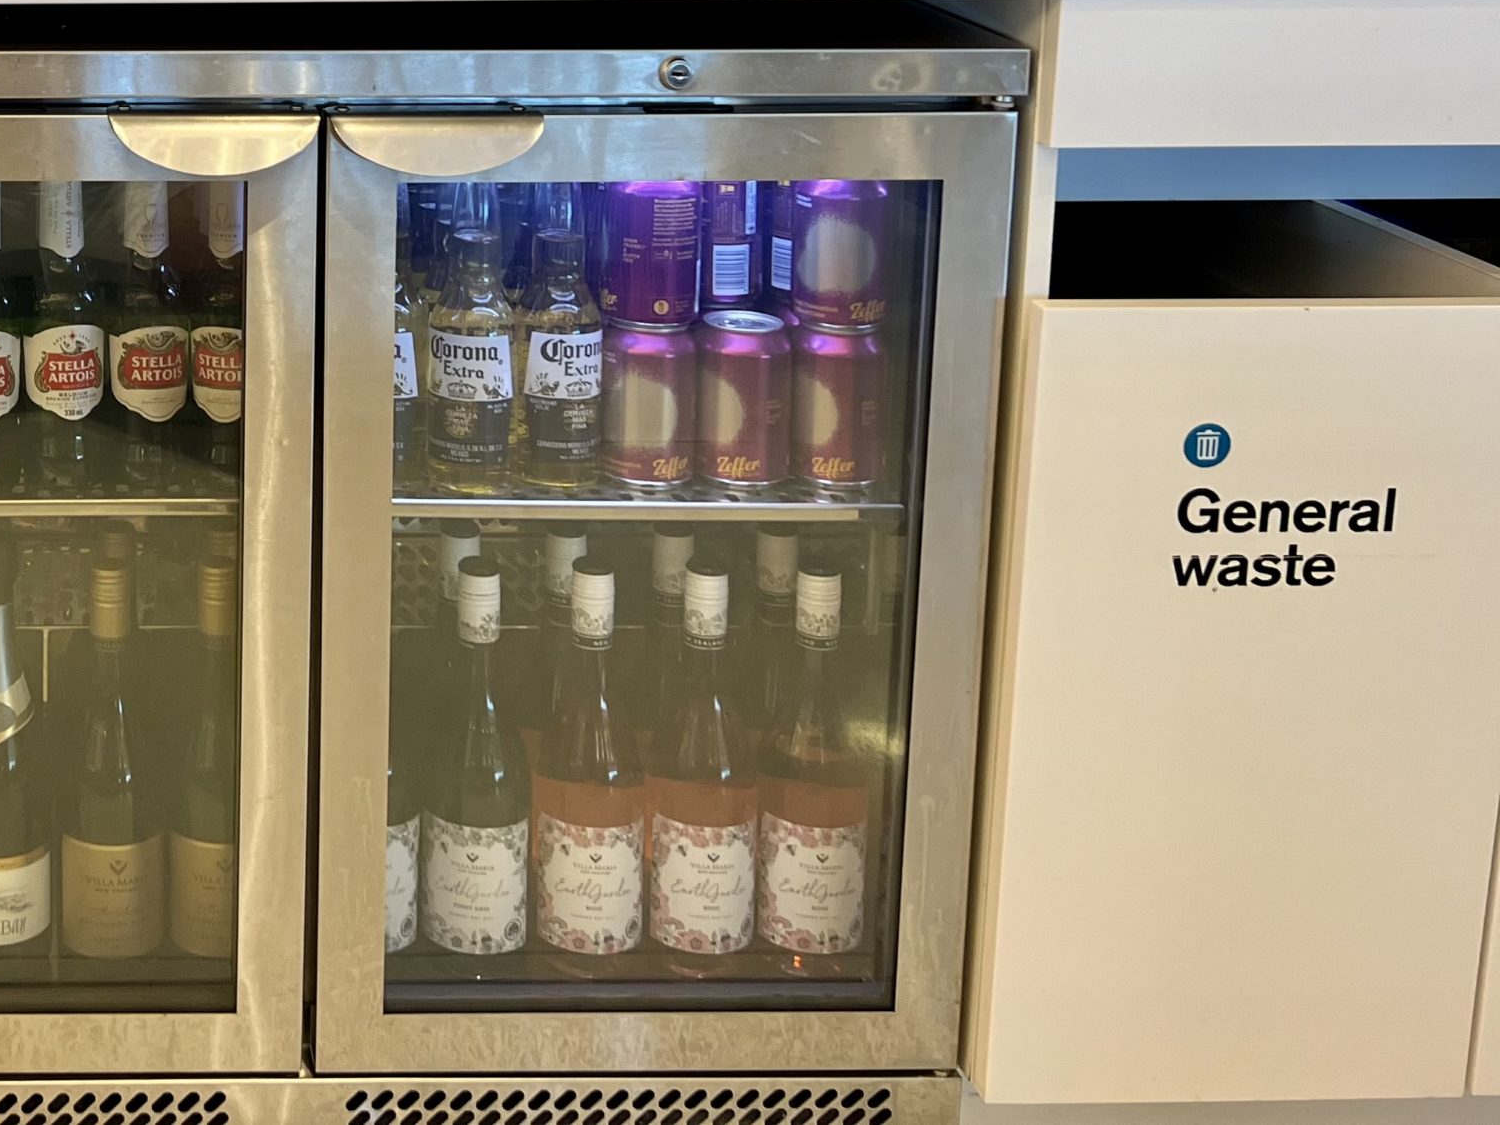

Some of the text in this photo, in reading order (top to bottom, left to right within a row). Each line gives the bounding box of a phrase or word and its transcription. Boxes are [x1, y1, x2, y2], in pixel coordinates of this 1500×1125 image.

[431, 334, 499, 363] Corona
[49, 358, 95, 372] STELLA
[131, 353, 183, 369] STELLA
[198, 353, 242, 369] STELL
[443, 360, 485, 379] Extra
[563, 361, 599, 377] Extra
[48, 370, 96, 383] ARTOIS
[131, 366, 183, 382] ARTOIS
[64, 409, 76, 417] 330
[653, 456, 688, 479] Zeffer
[716, 456, 761, 478] Zeffer
[811, 456, 856, 478] Zeffer
[1177, 487, 1397, 534] General
[1171, 543, 1336, 587] waste
